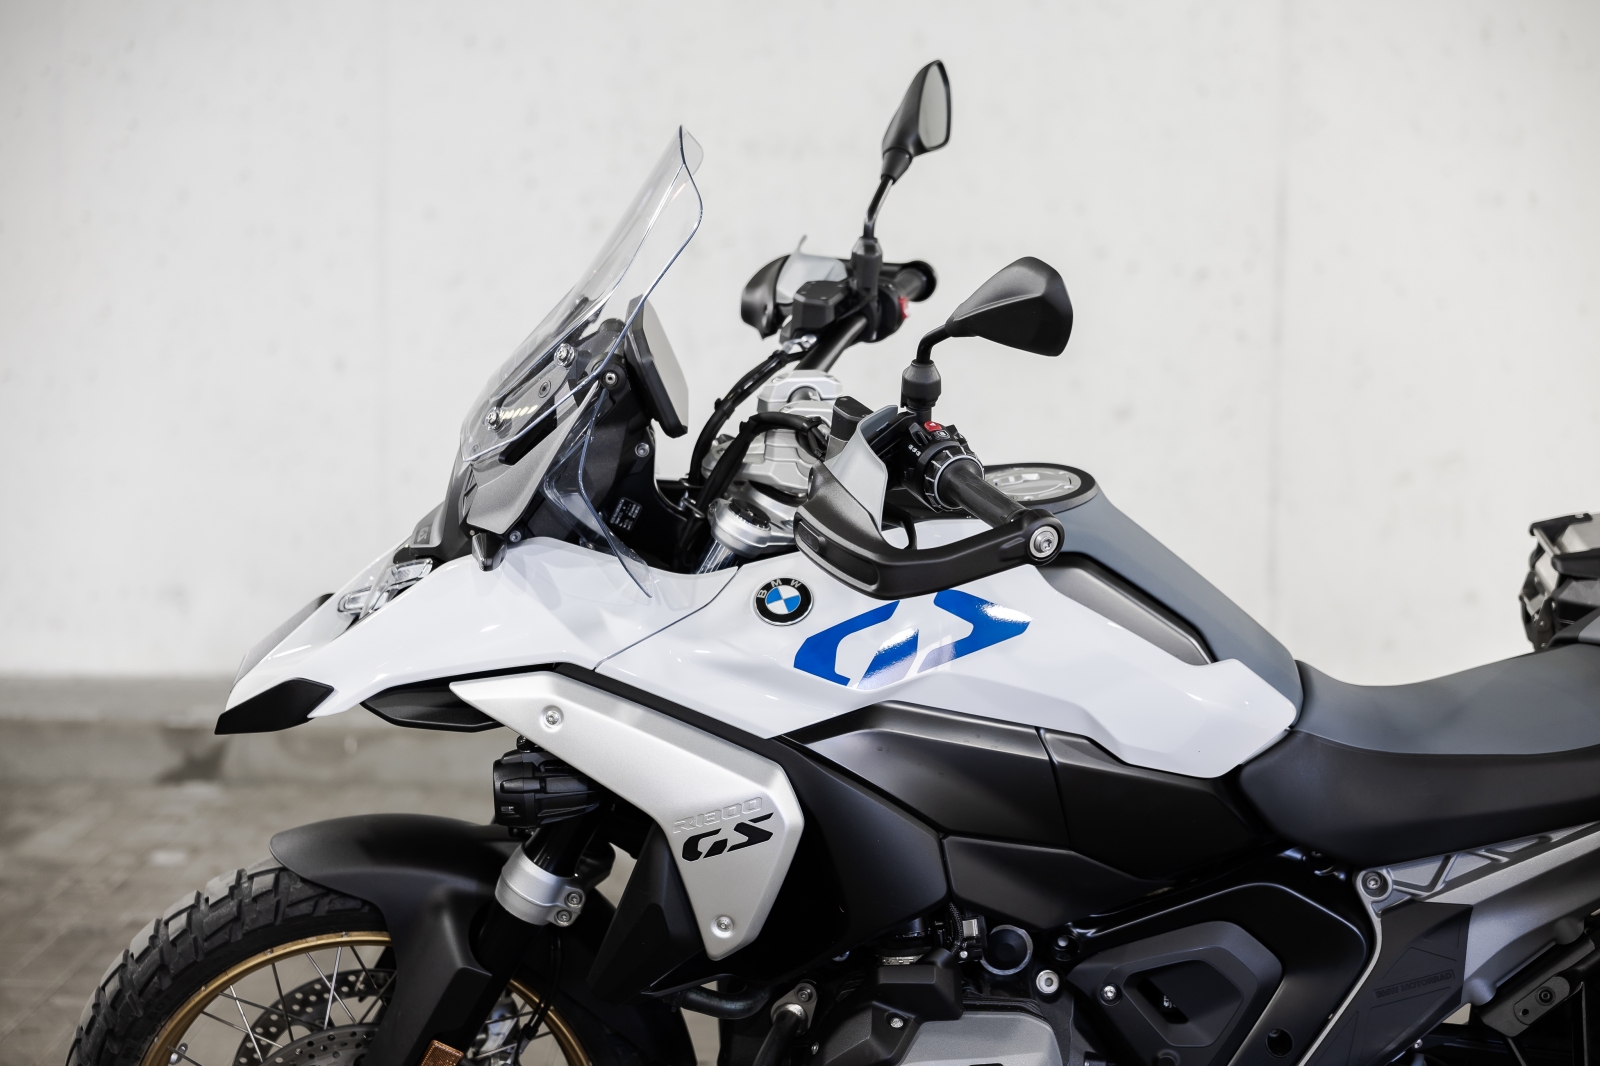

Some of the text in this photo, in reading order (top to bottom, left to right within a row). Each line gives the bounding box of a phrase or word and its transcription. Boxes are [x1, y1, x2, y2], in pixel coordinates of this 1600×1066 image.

[756, 578, 802, 599] BMW
[682, 811, 774, 862] GS
[1375, 972, 1453, 999] BMW MOTORRAD
